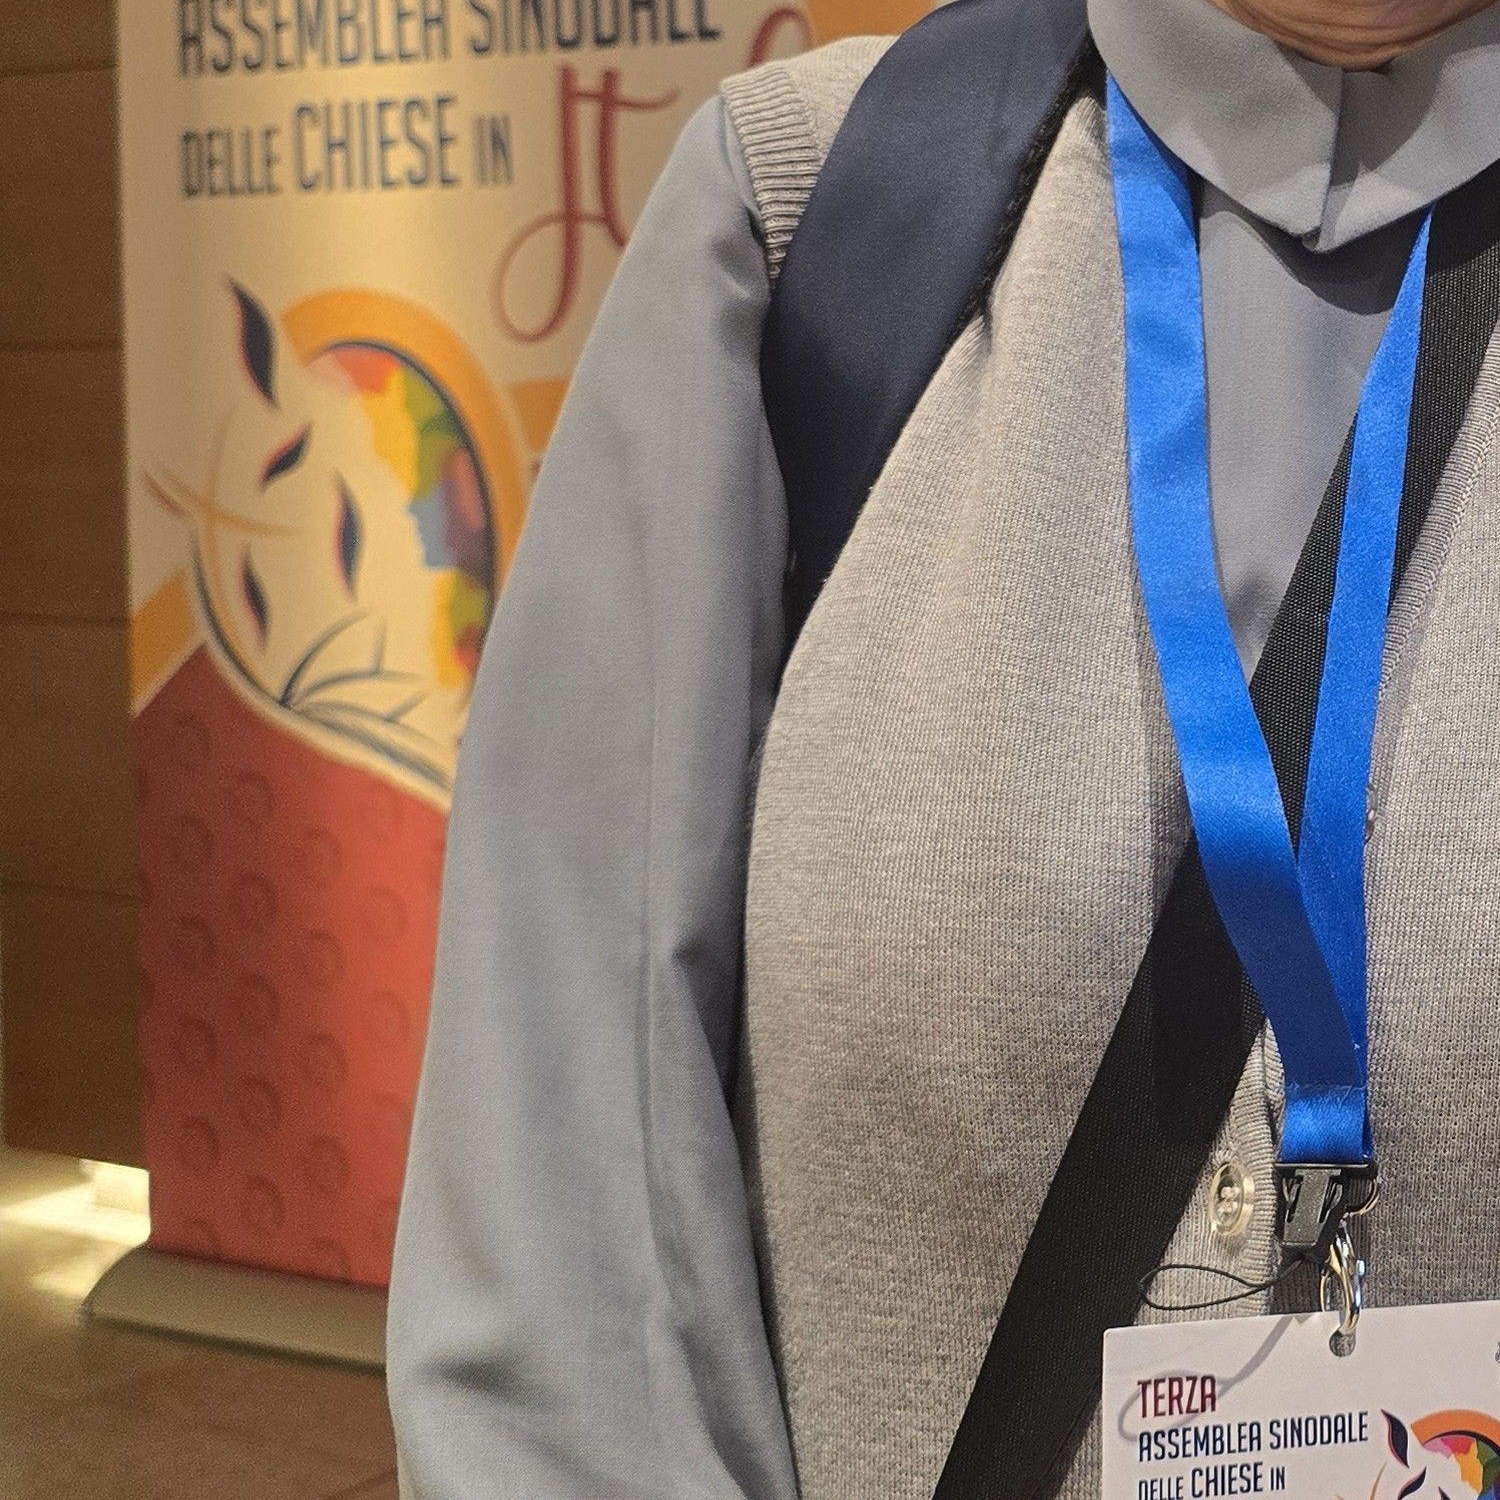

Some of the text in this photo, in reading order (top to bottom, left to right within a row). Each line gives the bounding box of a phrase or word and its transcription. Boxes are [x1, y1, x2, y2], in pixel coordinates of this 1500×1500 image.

[180, 92, 514, 197] DELLE CHIESE IN
[1137, 1375, 1217, 1418] TERZA
[1138, 1411, 1369, 1462] ASSEMBLEA SINODALE
[1138, 1461, 1286, 1500] DELLE CHIESE IN
